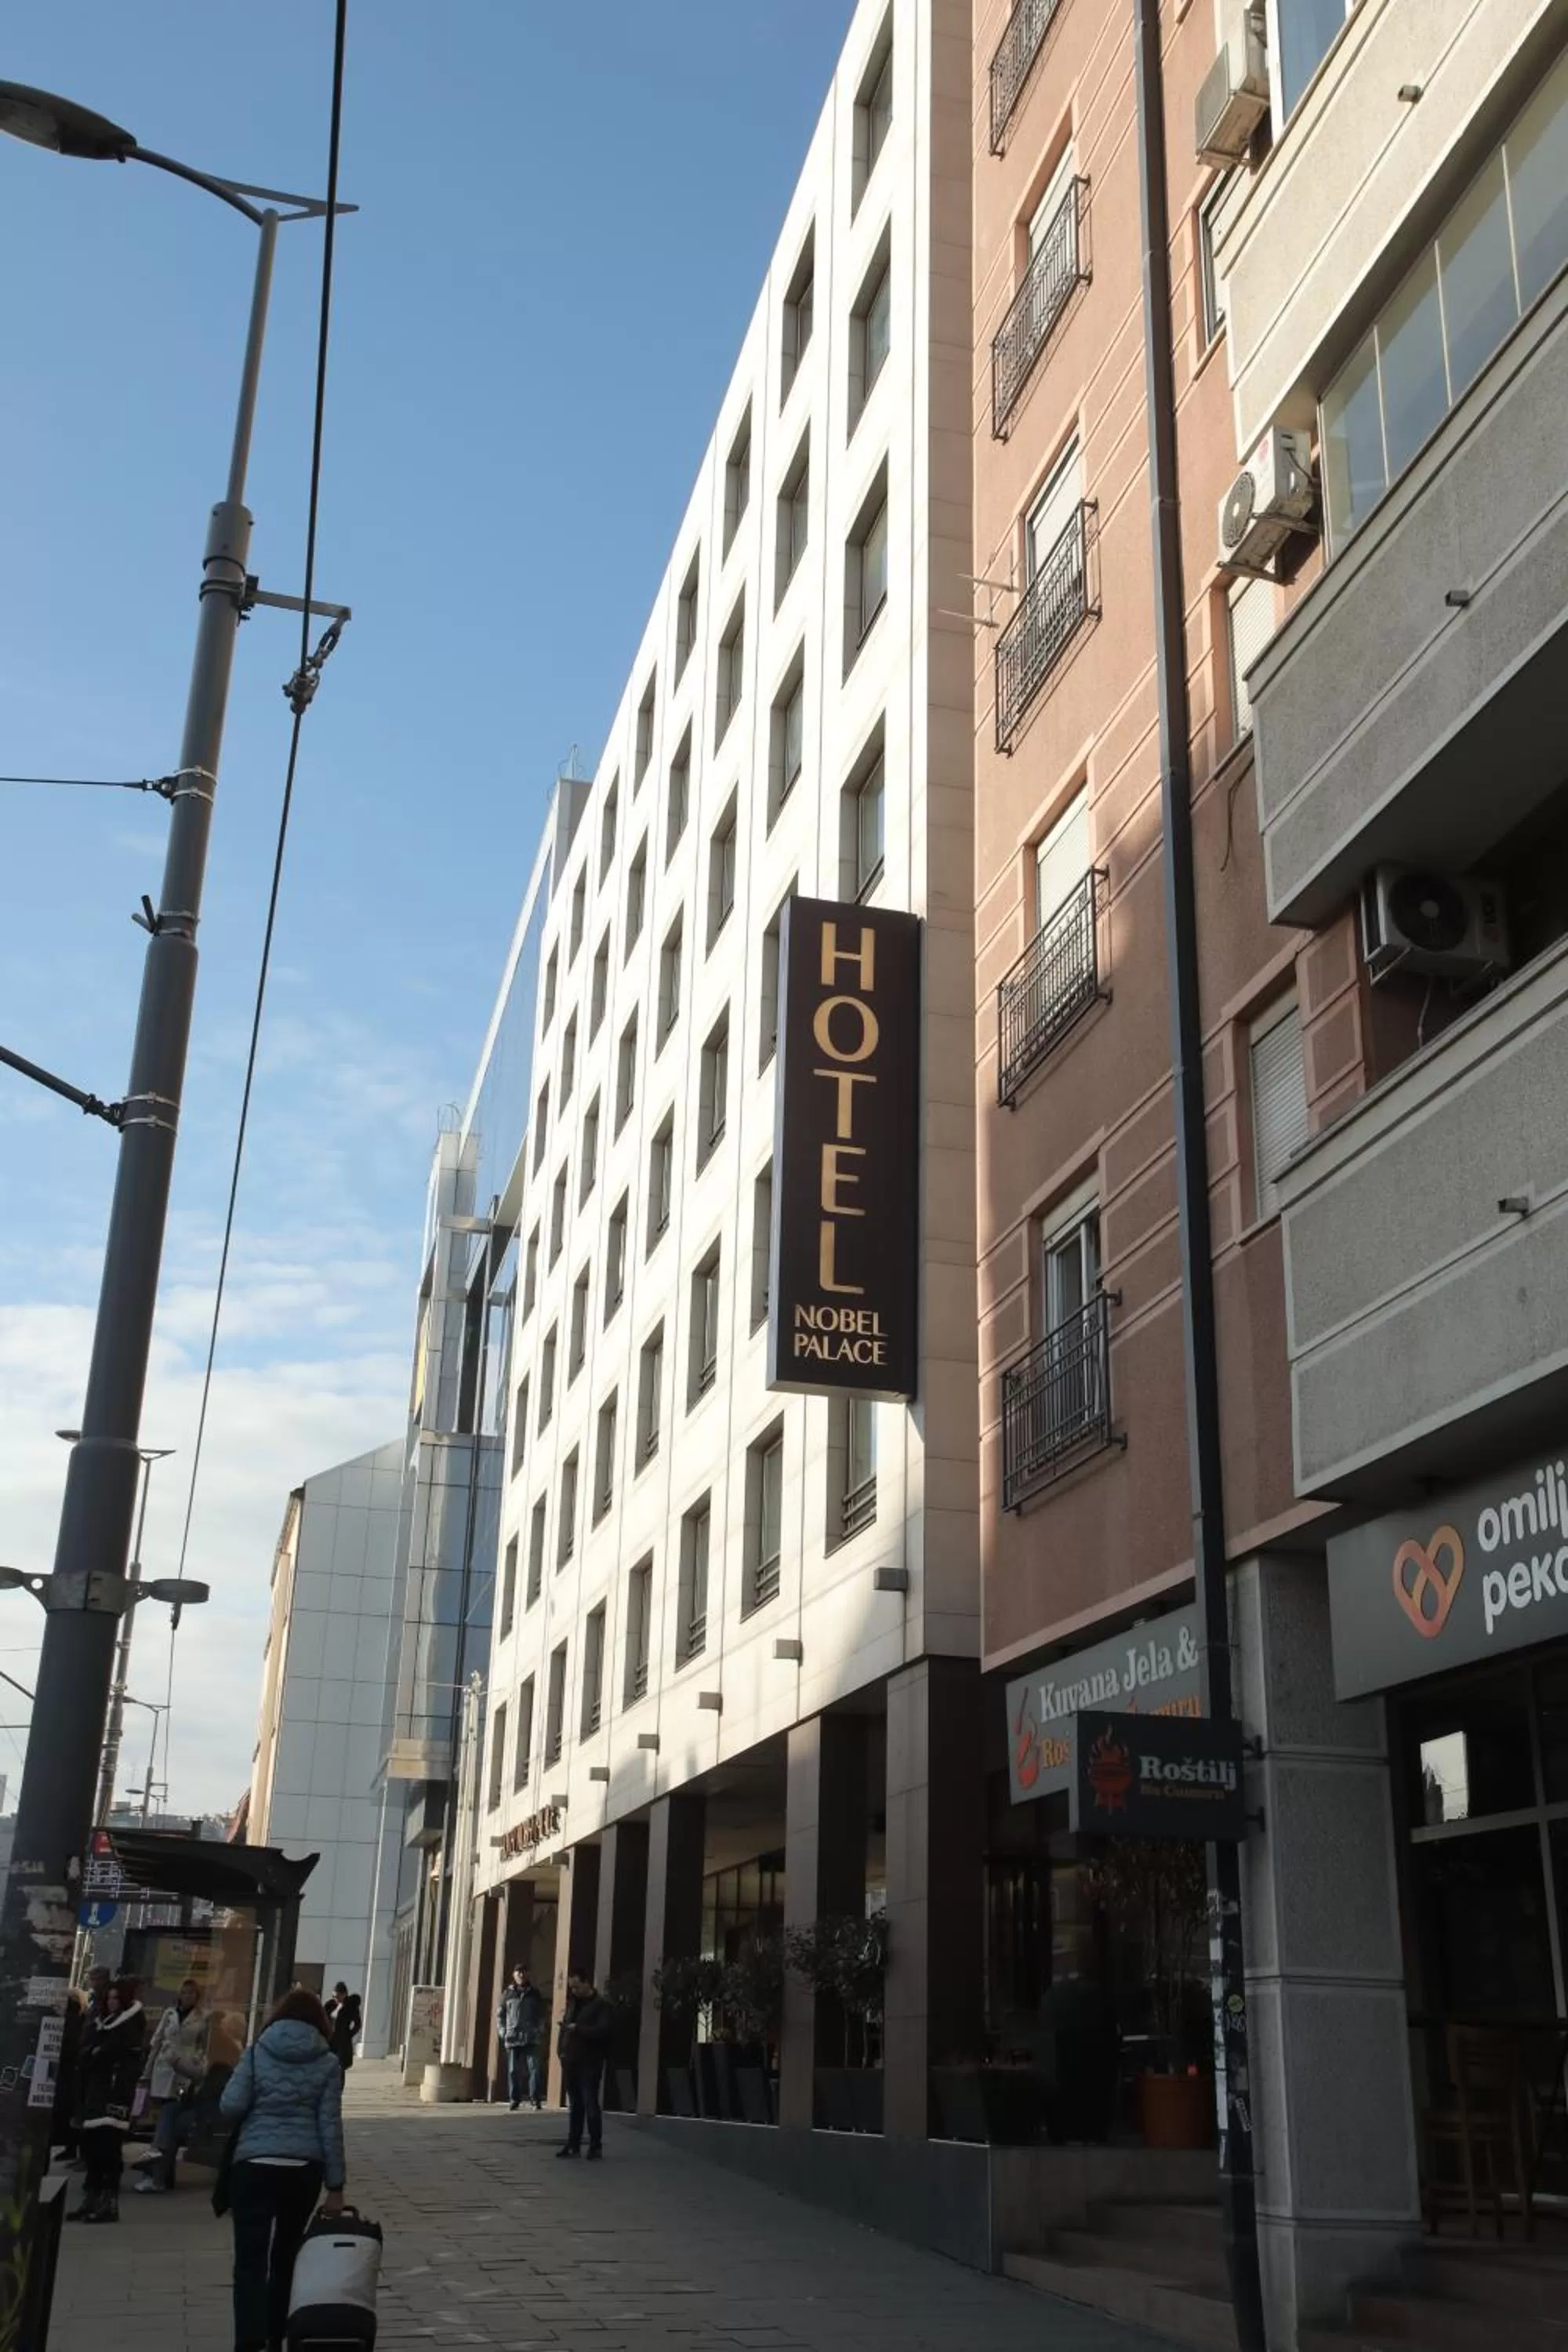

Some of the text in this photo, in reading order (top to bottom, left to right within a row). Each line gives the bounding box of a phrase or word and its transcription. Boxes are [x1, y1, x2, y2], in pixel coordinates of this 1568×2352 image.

[812, 921, 880, 1294] HOTEL
[793, 1304, 889, 1337] NOBEL
[793, 1333, 889, 1365] PALACE
[1039, 1668, 1120, 1722] Kuvana
[1123, 1639, 1174, 1691] Jela
[1177, 1626, 1199, 1671] &
[1138, 1755, 1236, 1791] Roštilj
